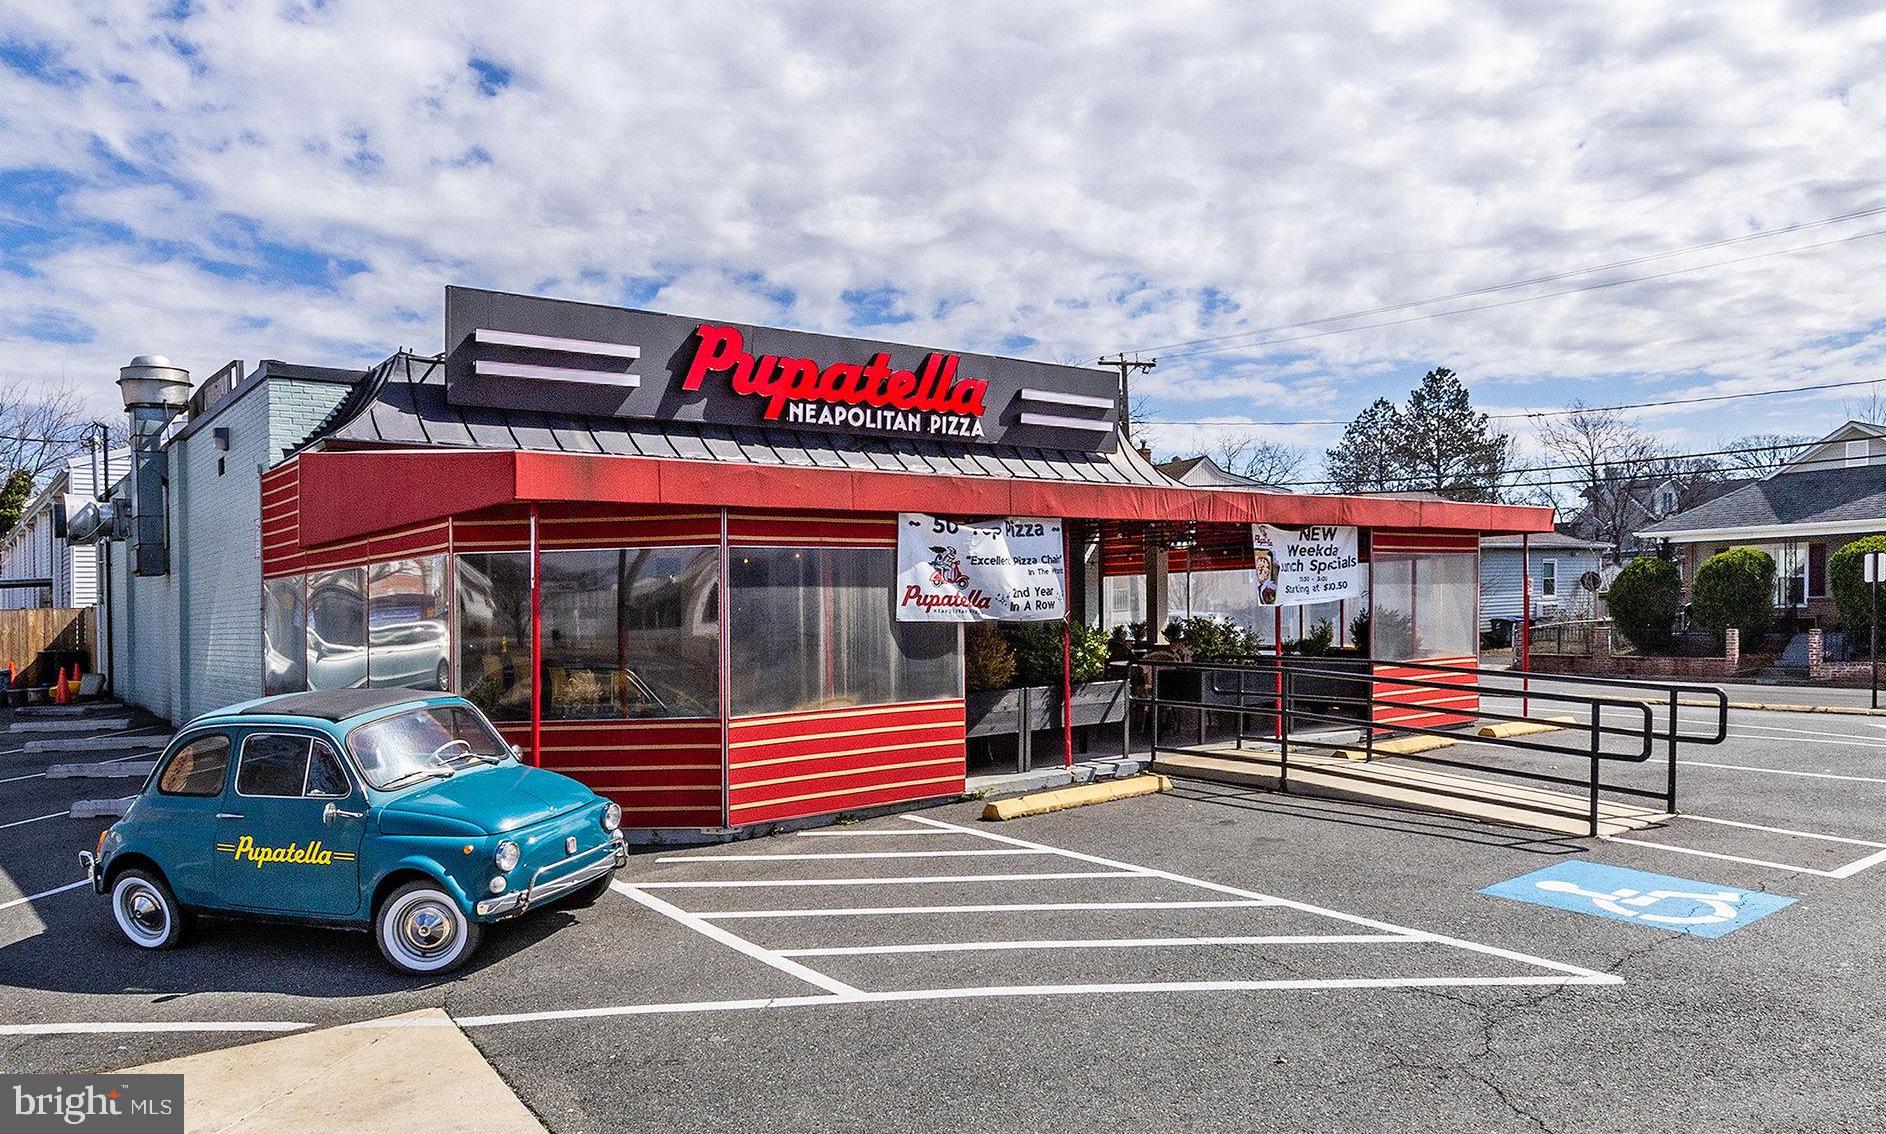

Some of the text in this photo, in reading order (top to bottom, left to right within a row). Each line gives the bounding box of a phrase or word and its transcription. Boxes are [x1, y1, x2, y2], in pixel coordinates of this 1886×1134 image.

[682, 324, 989, 420] Pupatella
[788, 402, 986, 437] NEAPOLITAN PIZZA
[932, 519, 960, 536] 50
[1004, 520, 1045, 538] Pizza
[1299, 526, 1338, 541] NEW
[1287, 544, 1339, 557] Weekda
[1013, 555, 1038, 566] Pizza
[1012, 586, 1054, 598] 2nd Year
[1323, 581, 1348, 592] $10.50
[901, 585, 992, 613] Pupatella
[1010, 600, 1056, 611] In A Row
[234, 835, 333, 868] Pupatella
